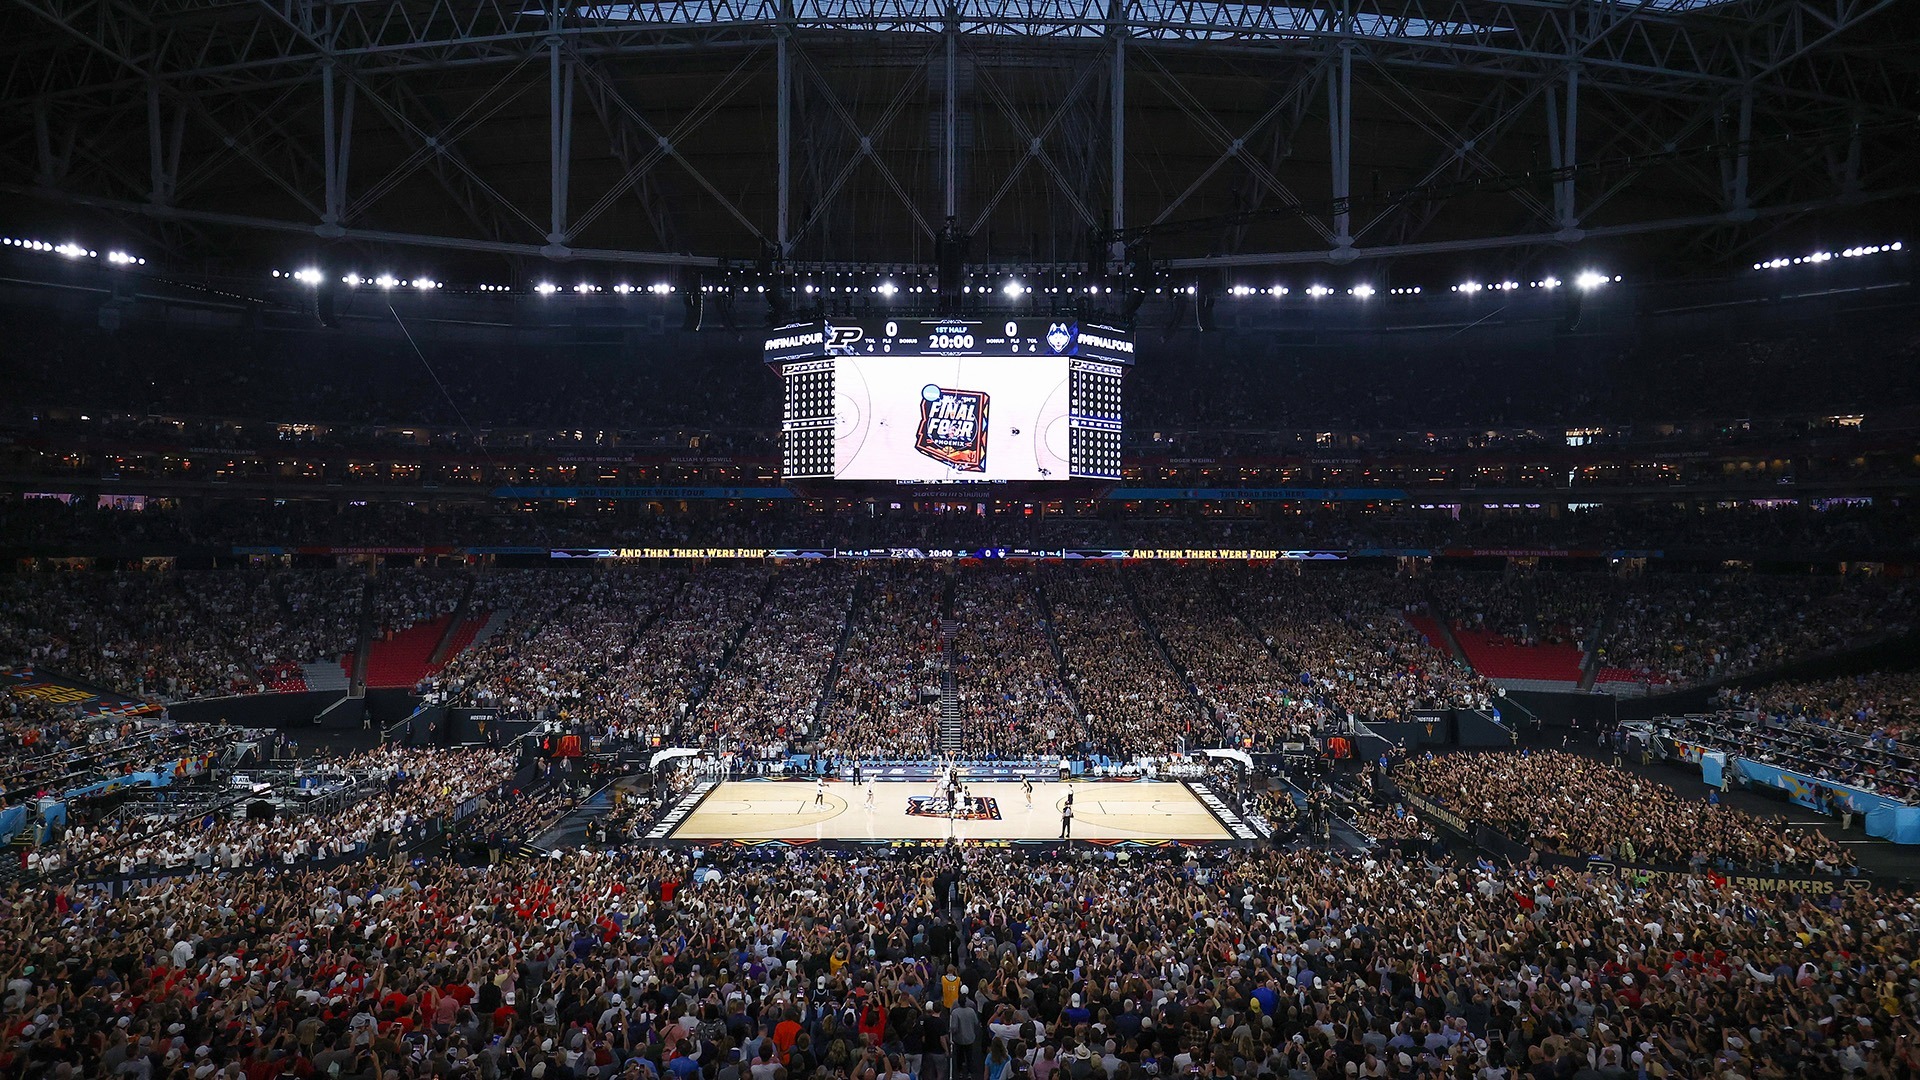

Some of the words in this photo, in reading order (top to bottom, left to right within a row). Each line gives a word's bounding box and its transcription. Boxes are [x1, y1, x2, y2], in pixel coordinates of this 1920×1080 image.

[886, 322, 898, 337] 0
[1005, 322, 1018, 337] 0
[765, 332, 823, 350] #MFINALFOUR
[867, 344, 874, 352] 4
[884, 344, 891, 352] 0
[929, 334, 974, 349] 20:00
[1012, 344, 1018, 352] 0
[1028, 344, 1036, 352] 4
[1078, 334, 1133, 353] #MFINALFOUR
[930, 401, 976, 420] FINAL
[928, 418, 975, 438] FOUR
[624, 489, 654, 497] THERE
[656, 489, 680, 497] WERE
[682, 489, 705, 497] FOUR
[620, 549, 642, 558] AND
[644, 549, 670, 558] THEN
[672, 549, 705, 558] THERE
[706, 549, 735, 558] WERE
[1133, 550, 1154, 558] AND
[1156, 550, 1182, 558] THEN
[1185, 550, 1217, 558] THERE
[1219, 550, 1247, 558] WERE
[1426, 802, 1468, 832] BOILERMAKERS
